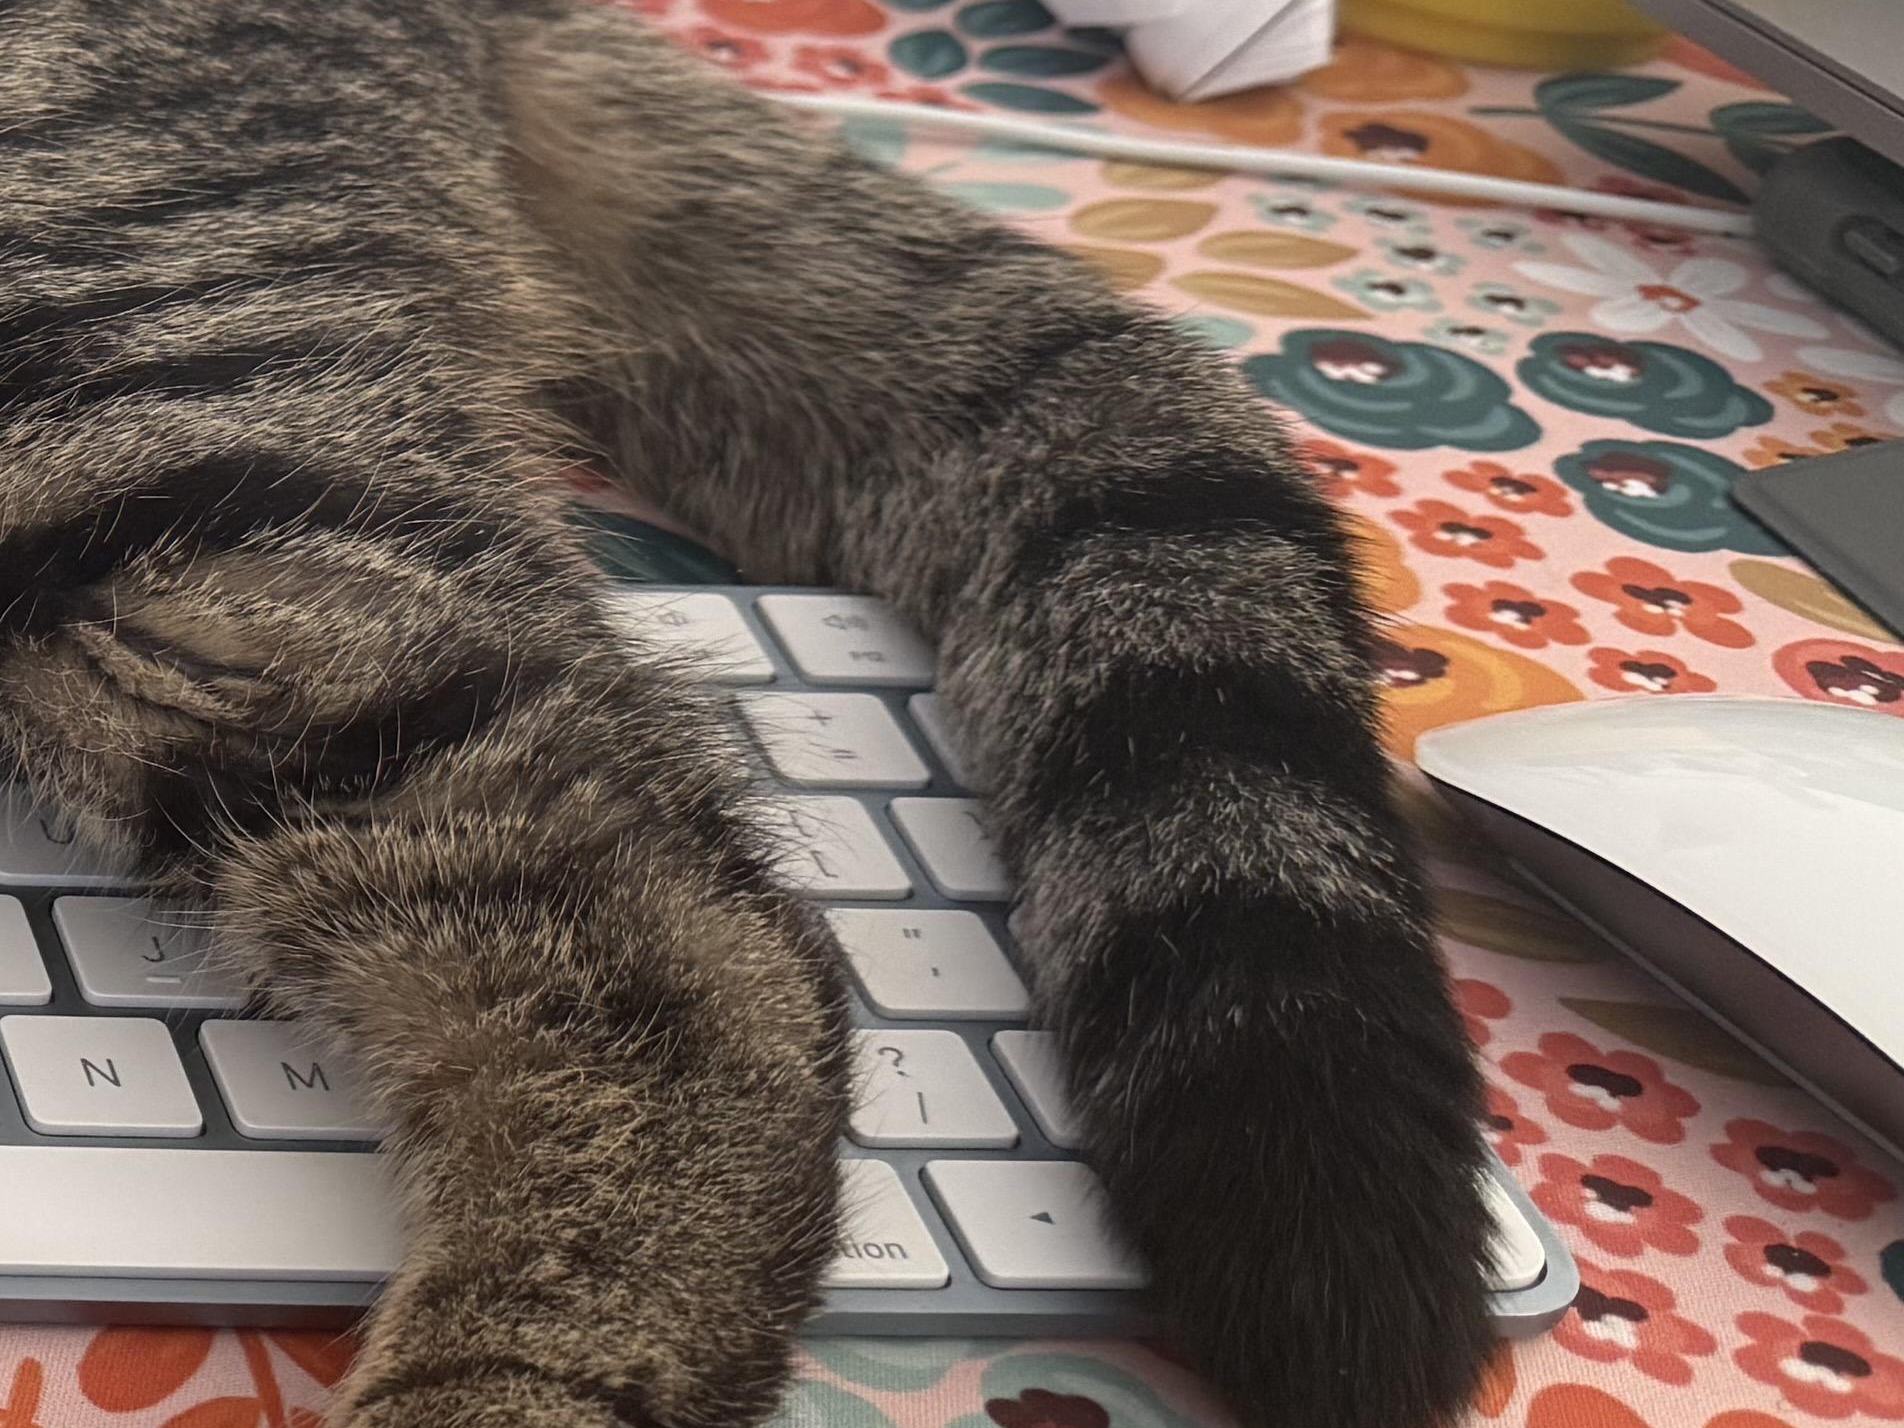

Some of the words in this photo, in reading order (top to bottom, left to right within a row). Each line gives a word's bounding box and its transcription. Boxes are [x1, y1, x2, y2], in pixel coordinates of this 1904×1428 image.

[141, 935, 165, 963] J
[81, 1058, 121, 1087] N
[280, 1061, 330, 1091] M
[840, 1240, 909, 1260] tion
